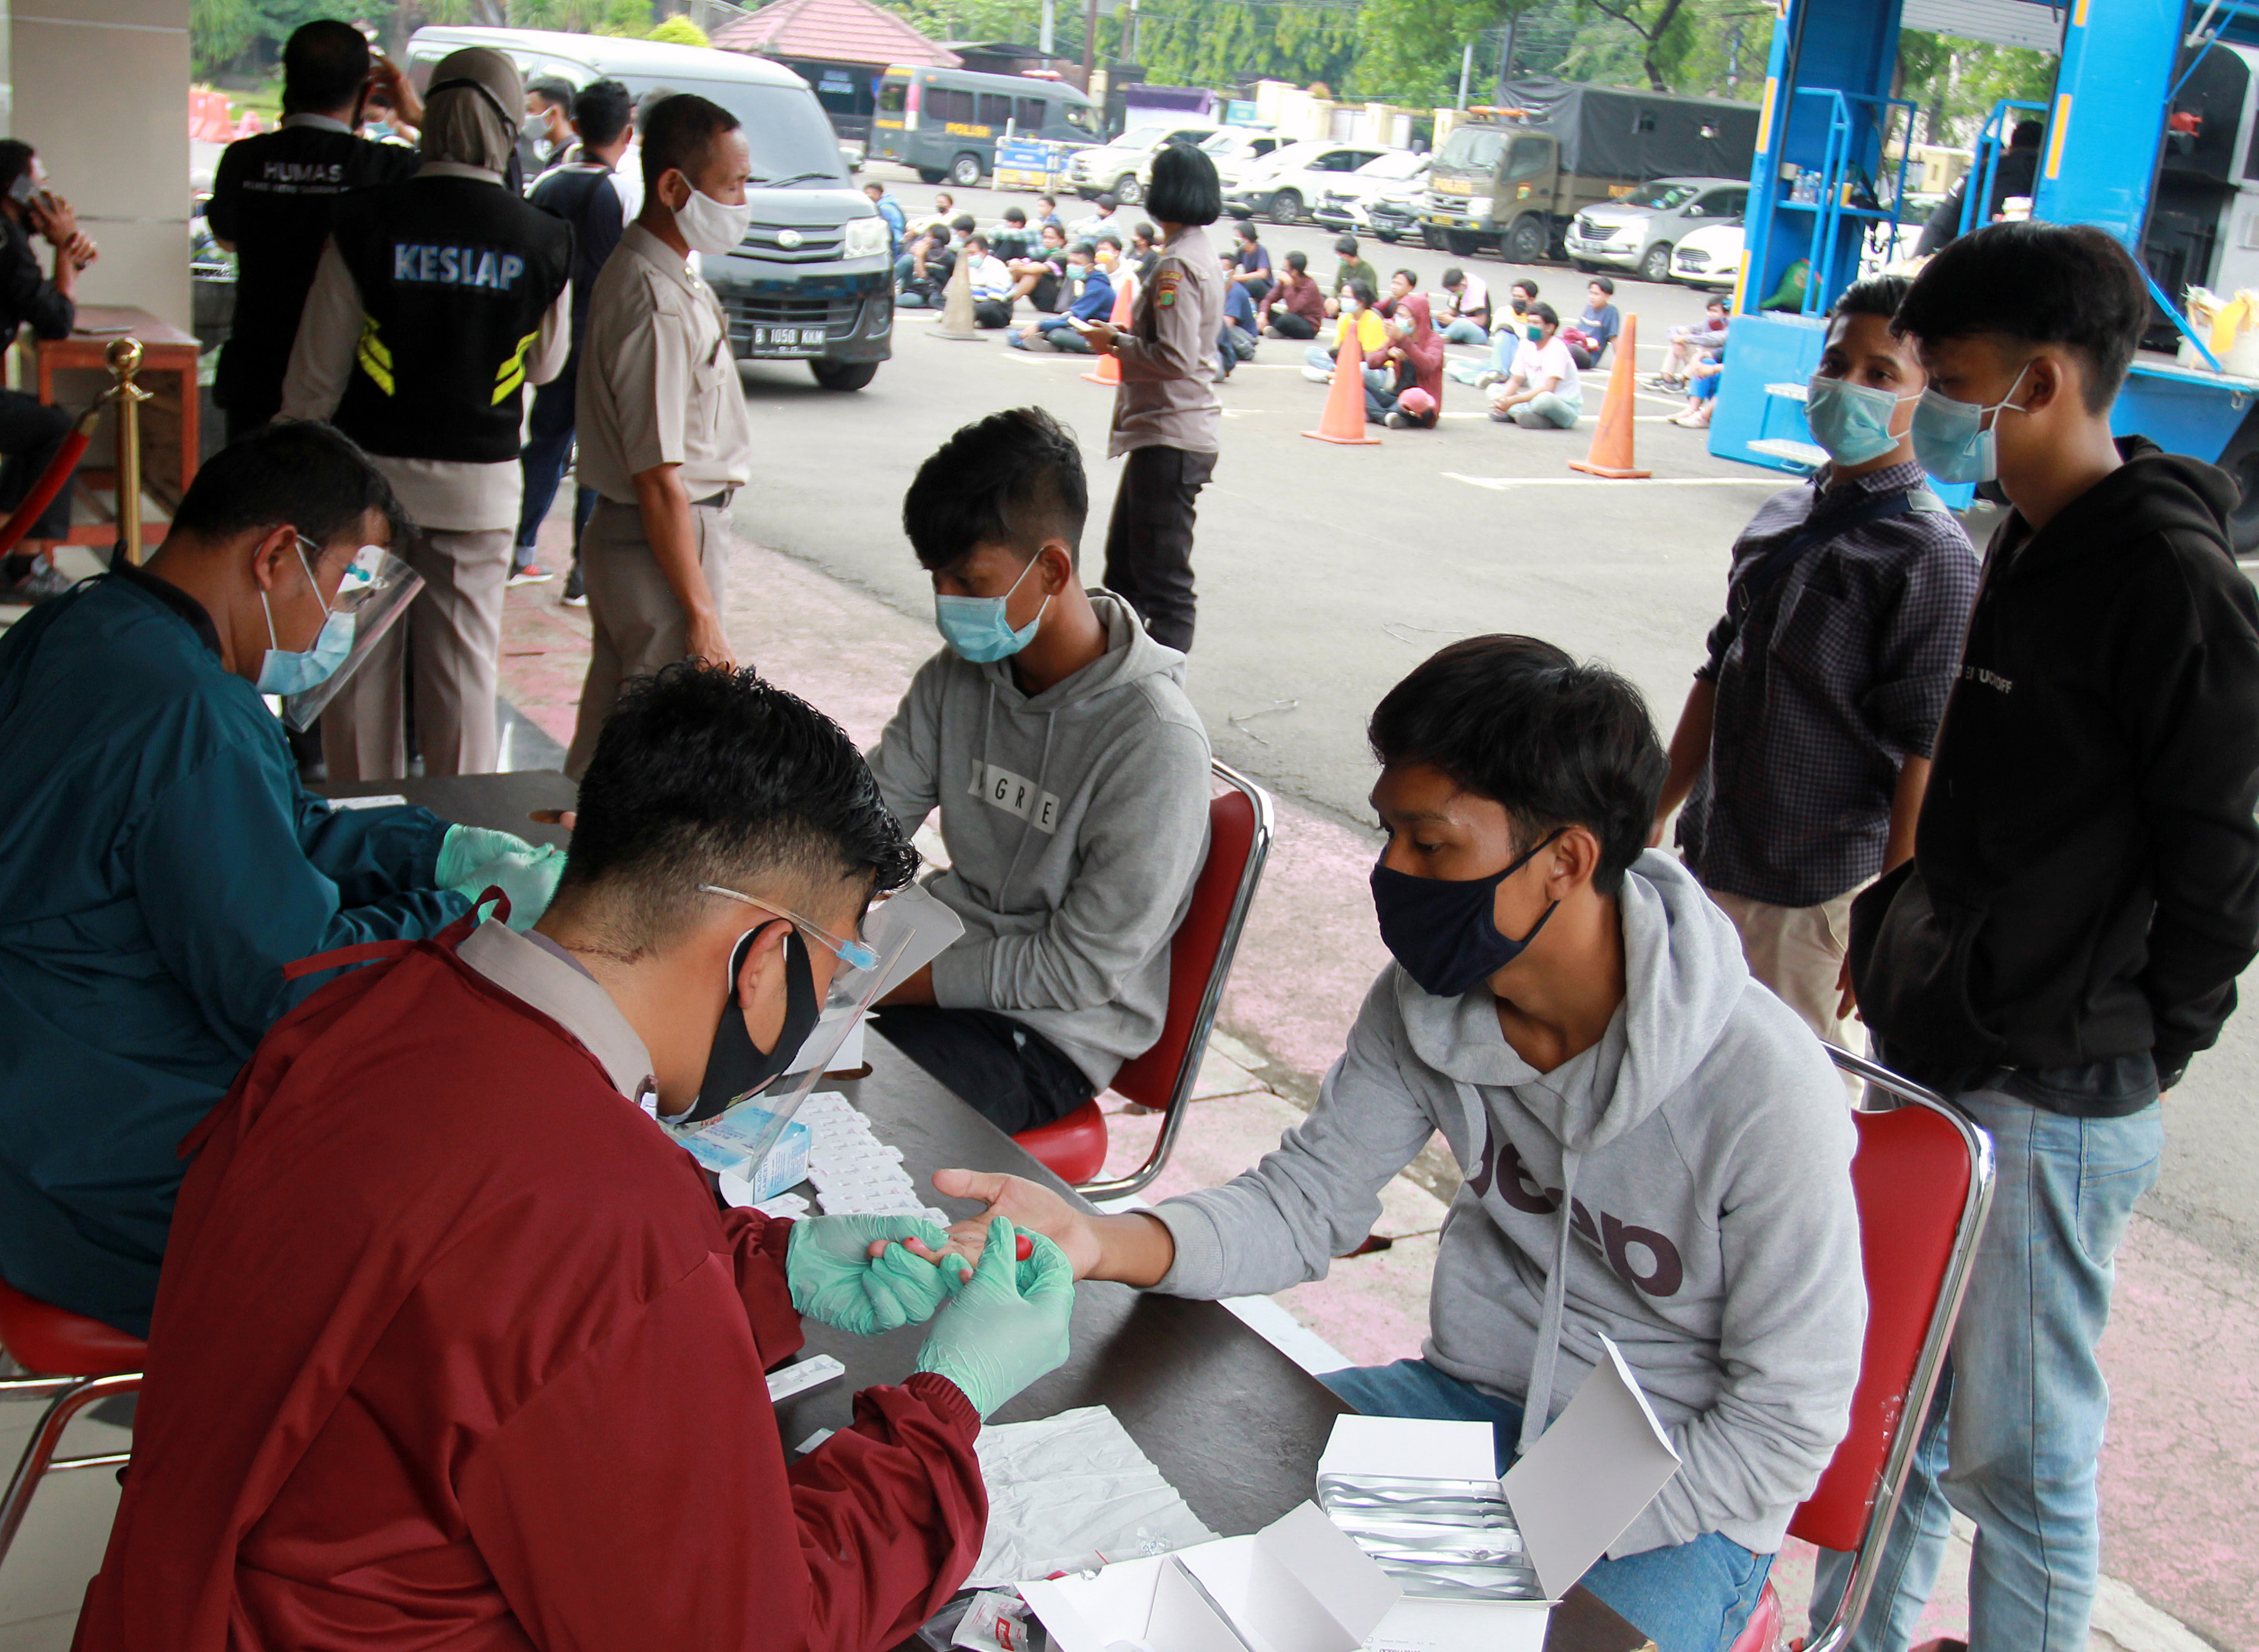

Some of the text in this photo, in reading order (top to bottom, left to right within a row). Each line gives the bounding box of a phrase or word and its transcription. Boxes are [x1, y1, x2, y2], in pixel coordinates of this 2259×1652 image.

[945, 122, 991, 139] POLISI
[264, 162, 343, 182] HUMAS
[394, 244, 525, 290] KESLAP
[755, 328, 765, 345] B
[771, 329, 798, 345] 1050
